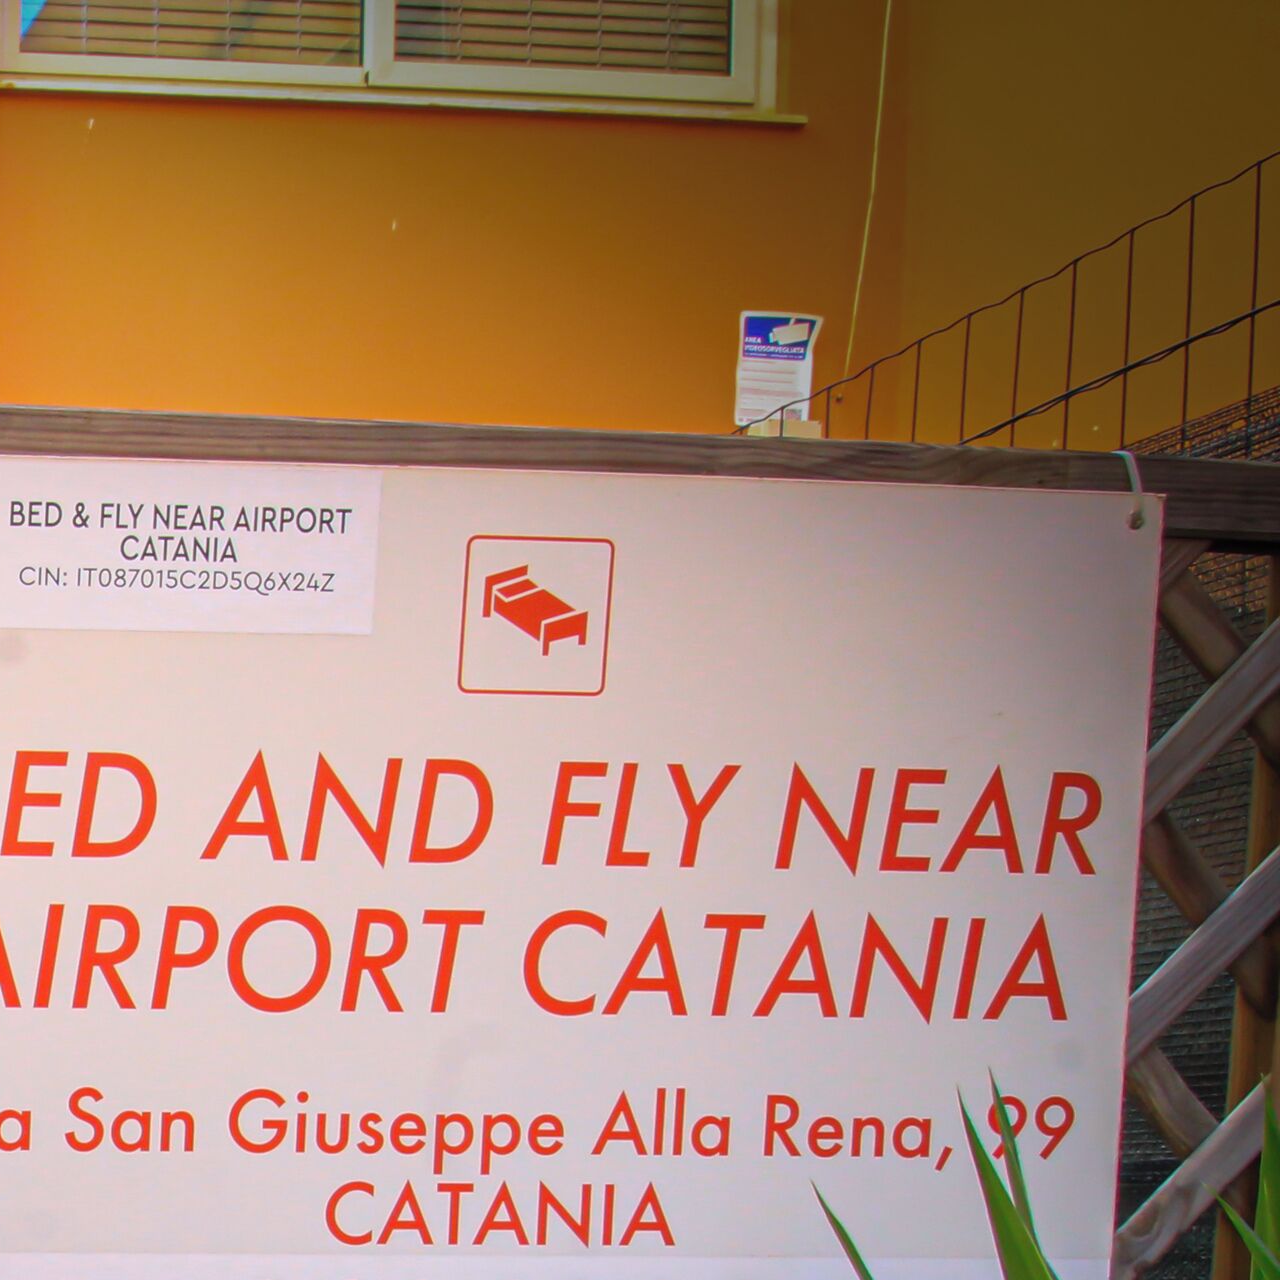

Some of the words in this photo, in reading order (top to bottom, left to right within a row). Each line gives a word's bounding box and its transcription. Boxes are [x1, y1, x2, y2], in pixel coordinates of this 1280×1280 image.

[10, 500, 63, 527] BED
[72, 502, 90, 528] &
[100, 503, 144, 529] FLY
[153, 504, 225, 531] NEAR
[233, 506, 353, 534] AIRPORT
[120, 534, 238, 563] CATANIA
[19, 566, 68, 587] CIN:
[76, 567, 336, 596] IT087015C2D5Q6X24Z
[201, 751, 494, 866] AND
[542, 760, 742, 869] FLY
[774, 764, 1101, 876] NEAR
[523, 909, 1067, 1023] CATANIA
[64, 1086, 195, 1153] San
[228, 1087, 564, 1176] Giuseppe
[591, 1087, 731, 1158] Alla
[763, 1094, 953, 1171] Rena,
[325, 1180, 674, 1247] CATANIA
